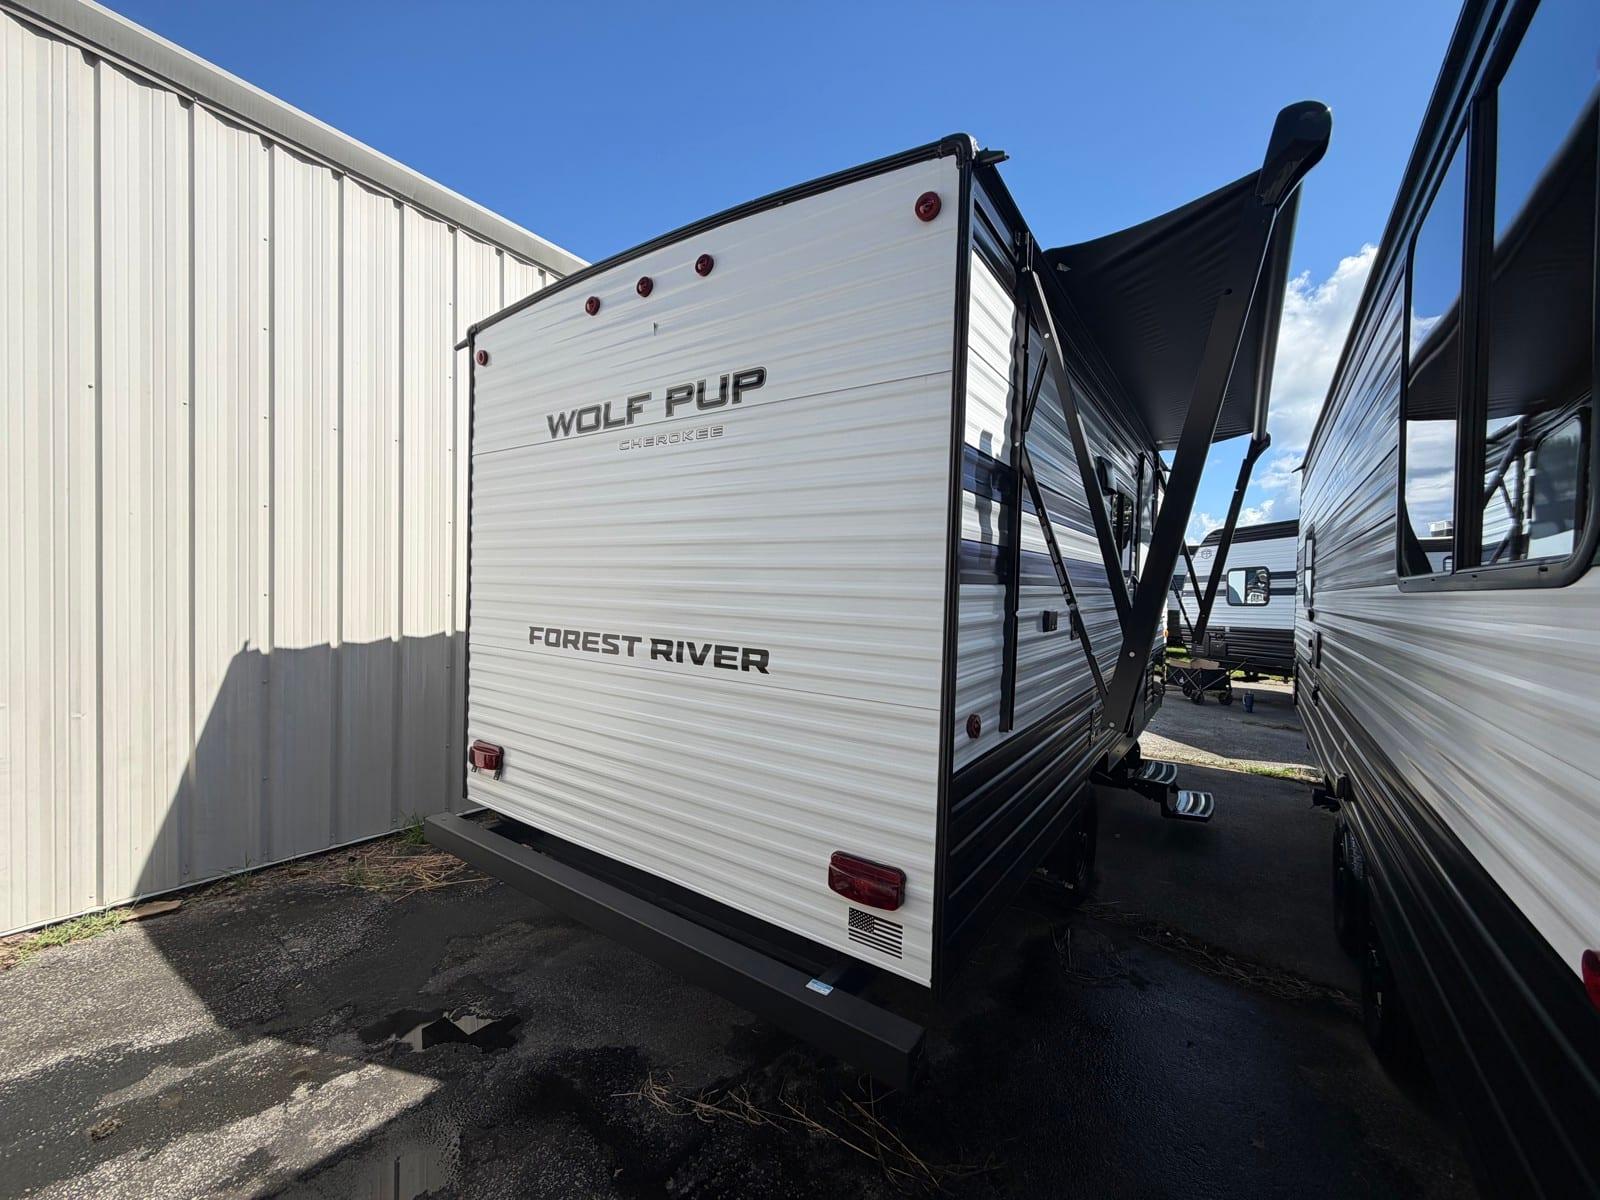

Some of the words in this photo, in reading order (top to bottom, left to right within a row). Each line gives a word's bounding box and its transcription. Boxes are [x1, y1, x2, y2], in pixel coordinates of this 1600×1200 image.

[547, 391, 652, 439] WOLF
[665, 366, 767, 417] PUP
[619, 425, 724, 451] CHEROKEE
[529, 626, 642, 657] FOREST
[650, 638, 770, 674] RIVER
